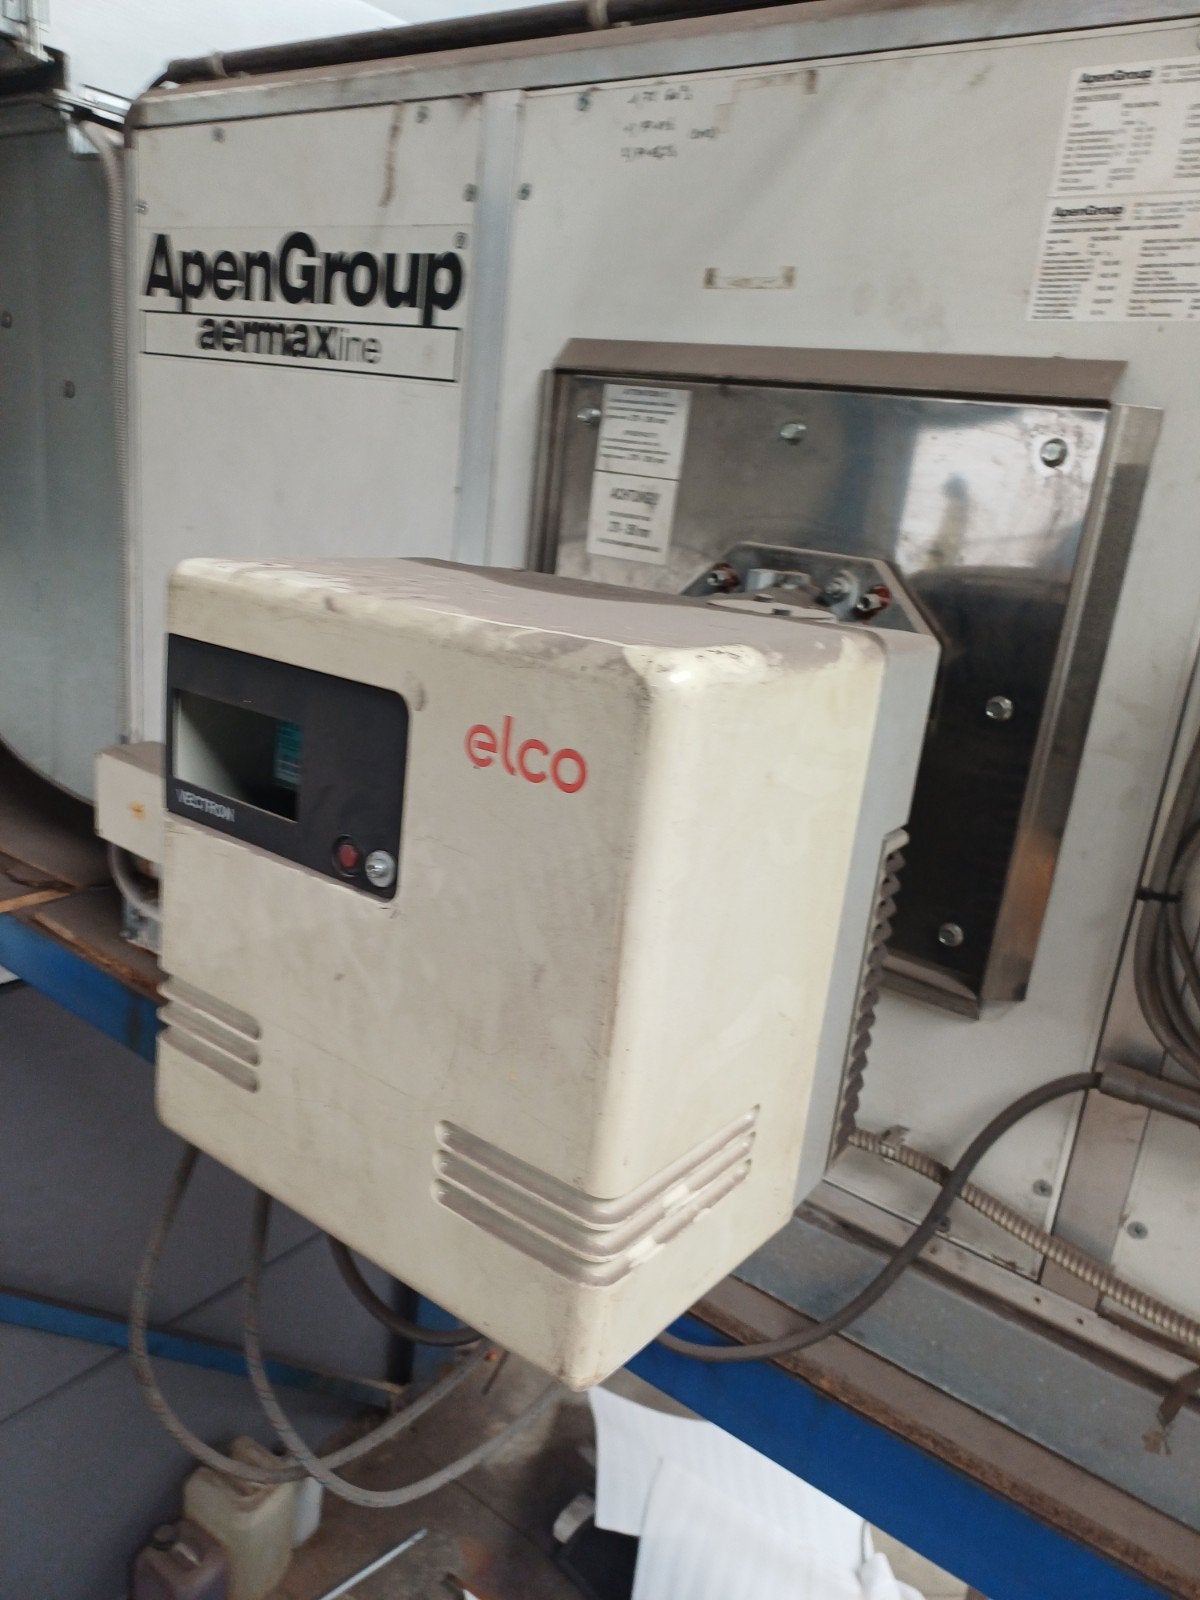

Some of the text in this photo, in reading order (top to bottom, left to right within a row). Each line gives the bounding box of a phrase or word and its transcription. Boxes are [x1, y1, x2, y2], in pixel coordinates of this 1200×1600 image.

[146, 231, 464, 327] ApenGroup
[464, 714, 588, 794] elco
[175, 788, 236, 822] VECTRON
